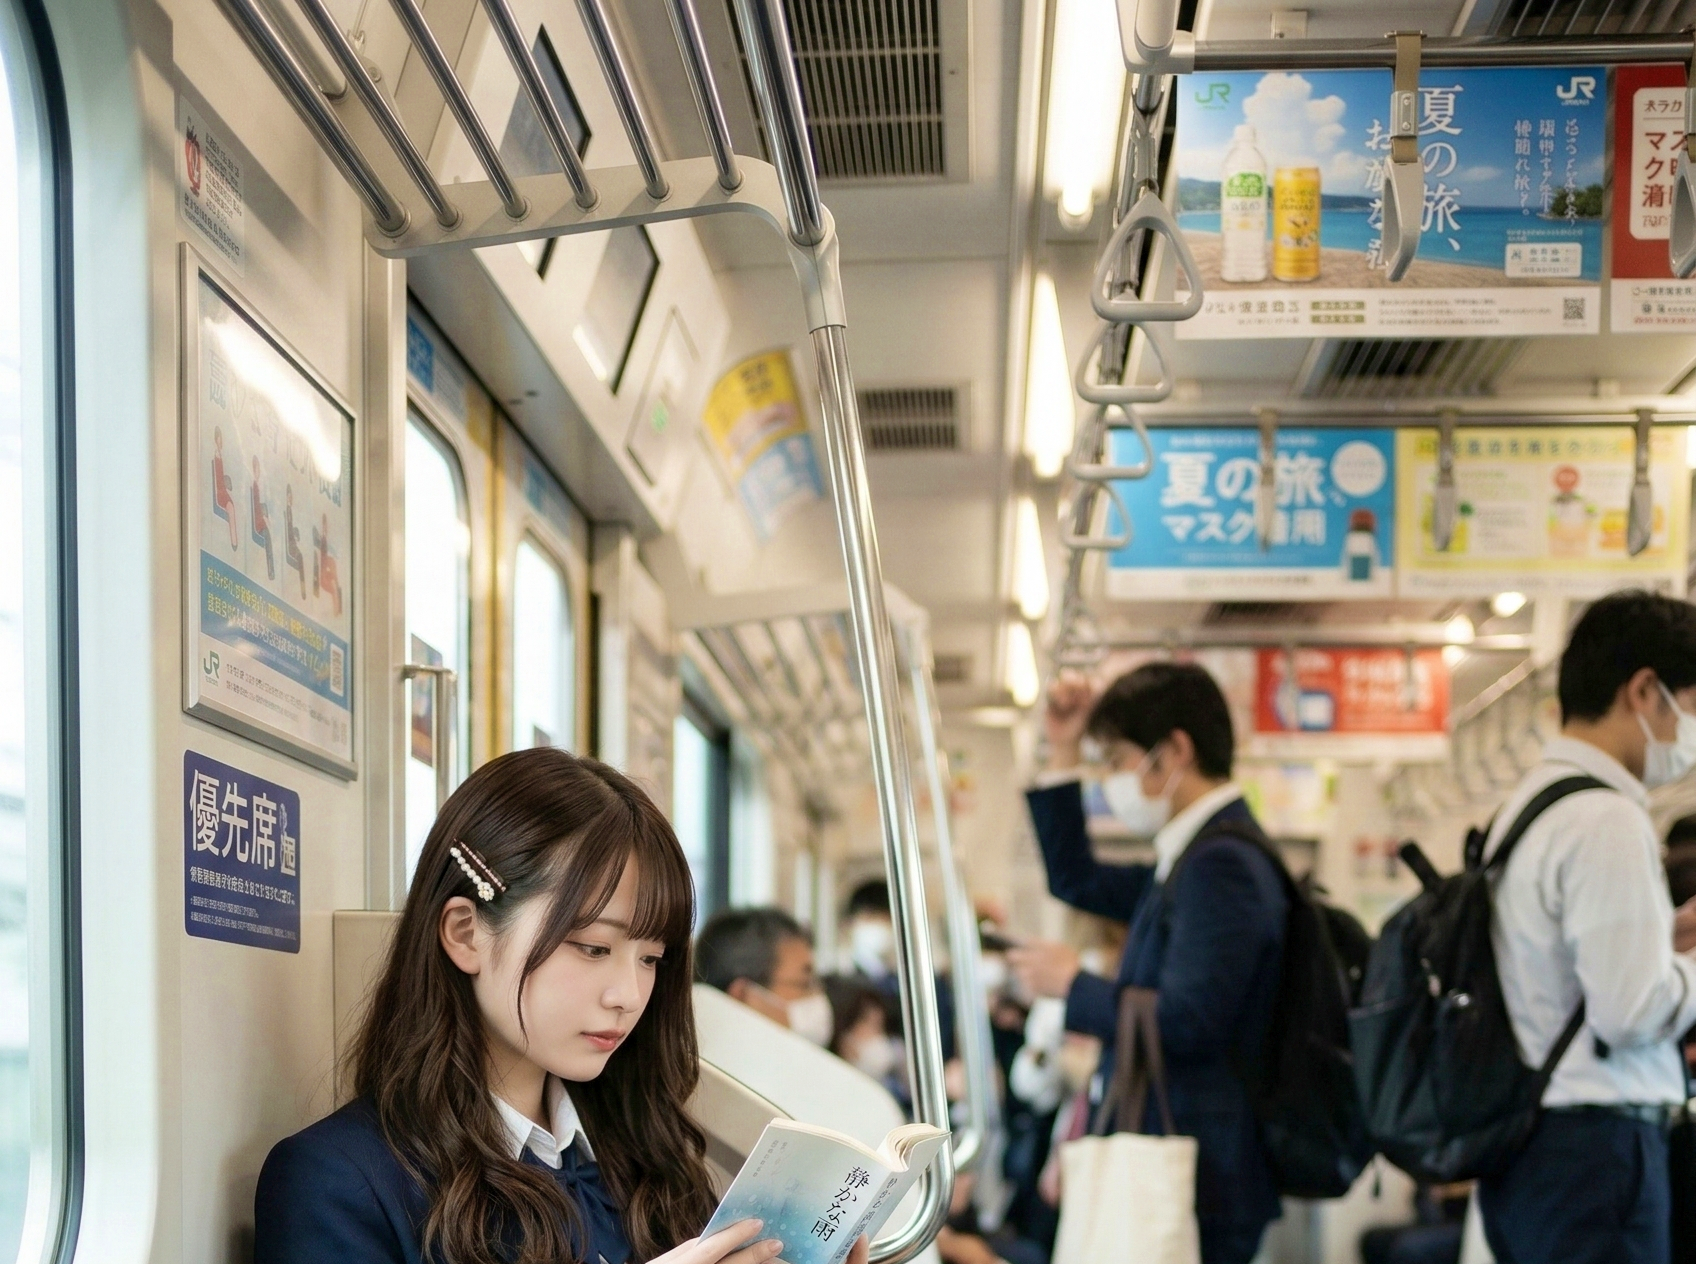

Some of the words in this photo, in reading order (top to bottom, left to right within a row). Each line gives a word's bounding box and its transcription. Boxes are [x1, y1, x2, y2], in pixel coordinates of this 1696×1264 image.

[1195, 83, 1231, 104] JR
[1556, 76, 1596, 99] JR
[203, 650, 220, 679] JR
[189, 768, 277, 870] 優先席
